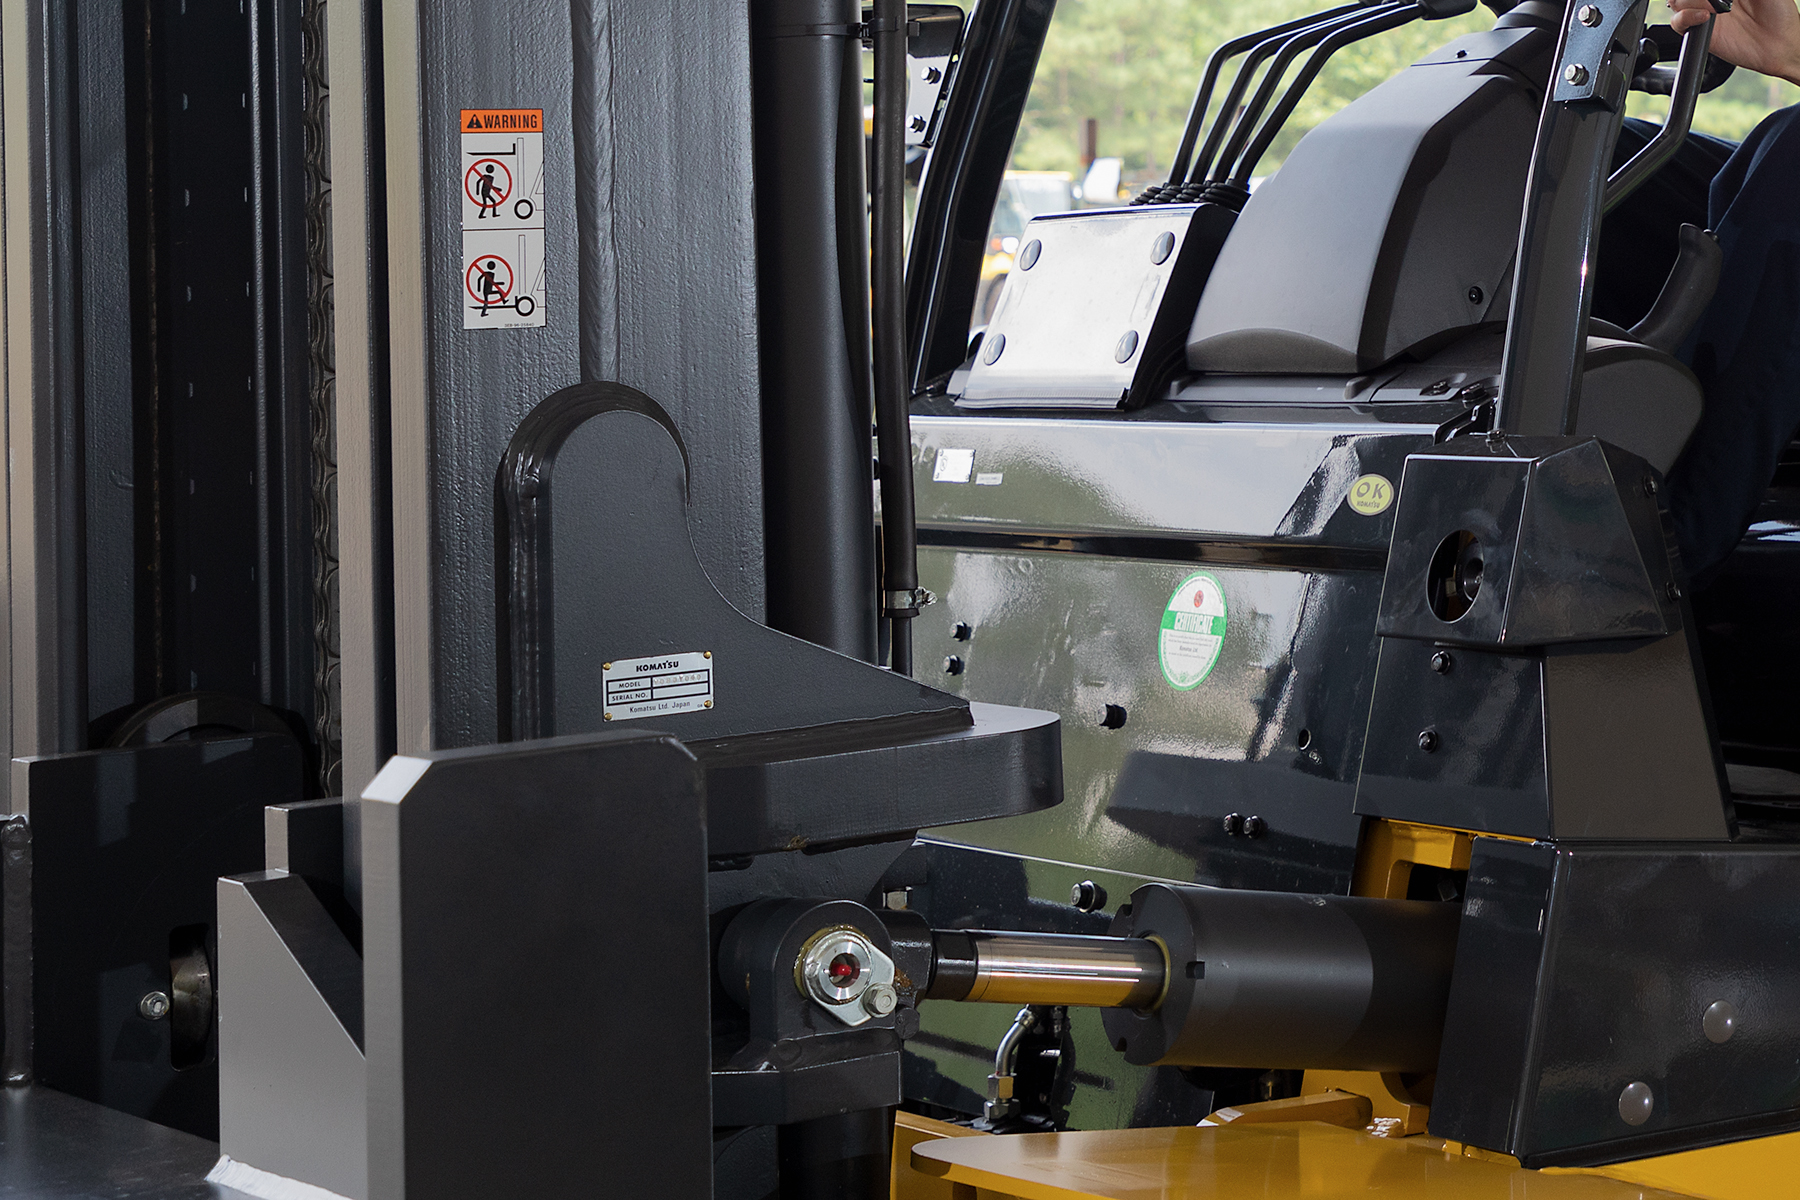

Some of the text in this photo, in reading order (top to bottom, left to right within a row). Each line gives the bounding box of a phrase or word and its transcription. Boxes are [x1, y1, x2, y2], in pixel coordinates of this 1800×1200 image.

[484, 114, 537, 128] WARNING
[1357, 482, 1386, 499] OK
[1174, 612, 1214, 634] CERTIFICATE
[636, 660, 680, 672] KOMATSU
[672, 701, 691, 709] Japan
